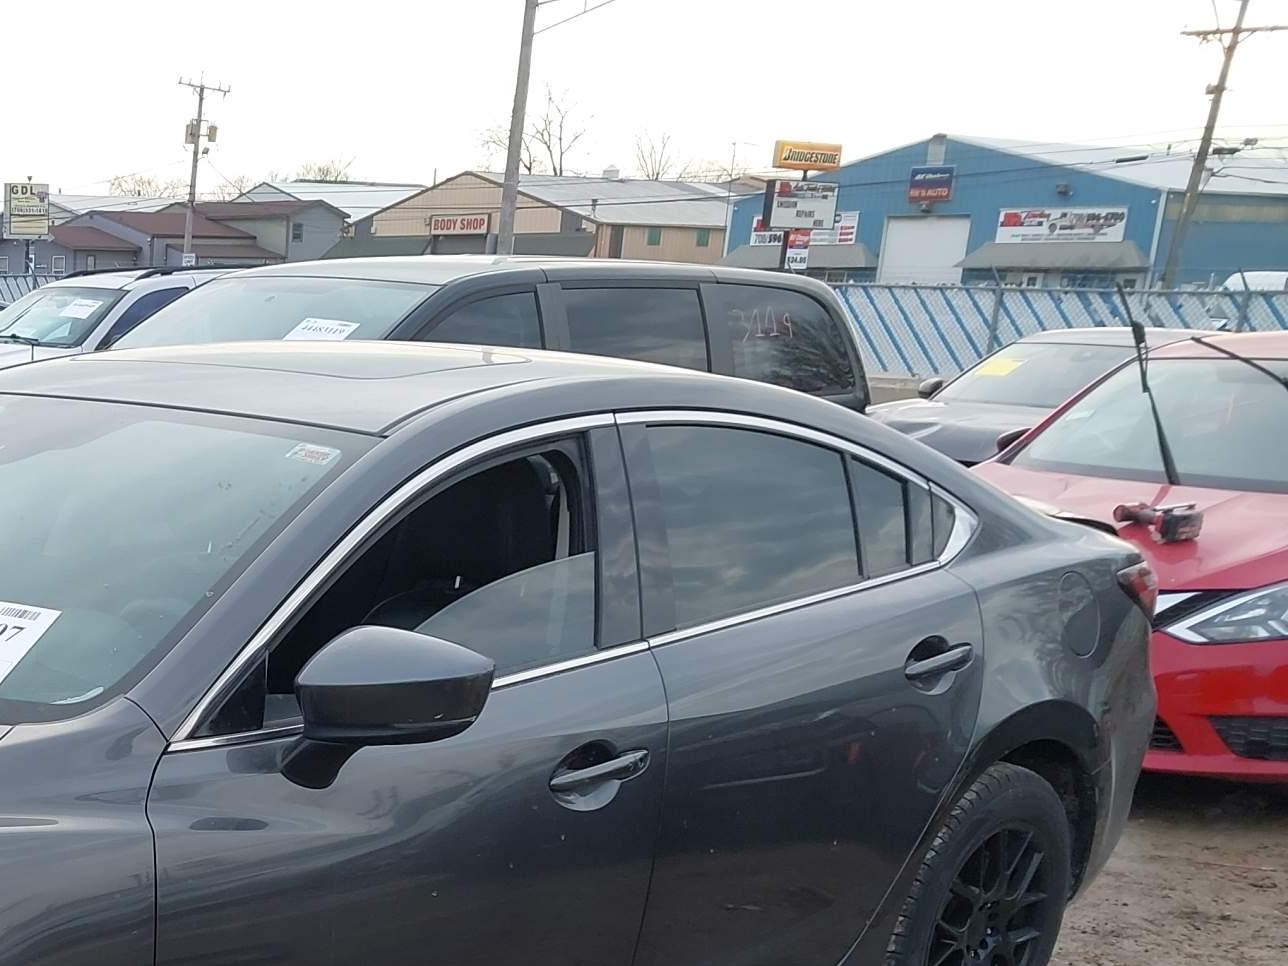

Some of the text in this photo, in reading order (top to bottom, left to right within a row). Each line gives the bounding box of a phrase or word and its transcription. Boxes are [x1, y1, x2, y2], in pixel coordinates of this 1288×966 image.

[782, 147, 839, 164] BRIDGESTONE
[11, 185, 36, 196] GDL
[433, 217, 486, 231] BODY SHOP
